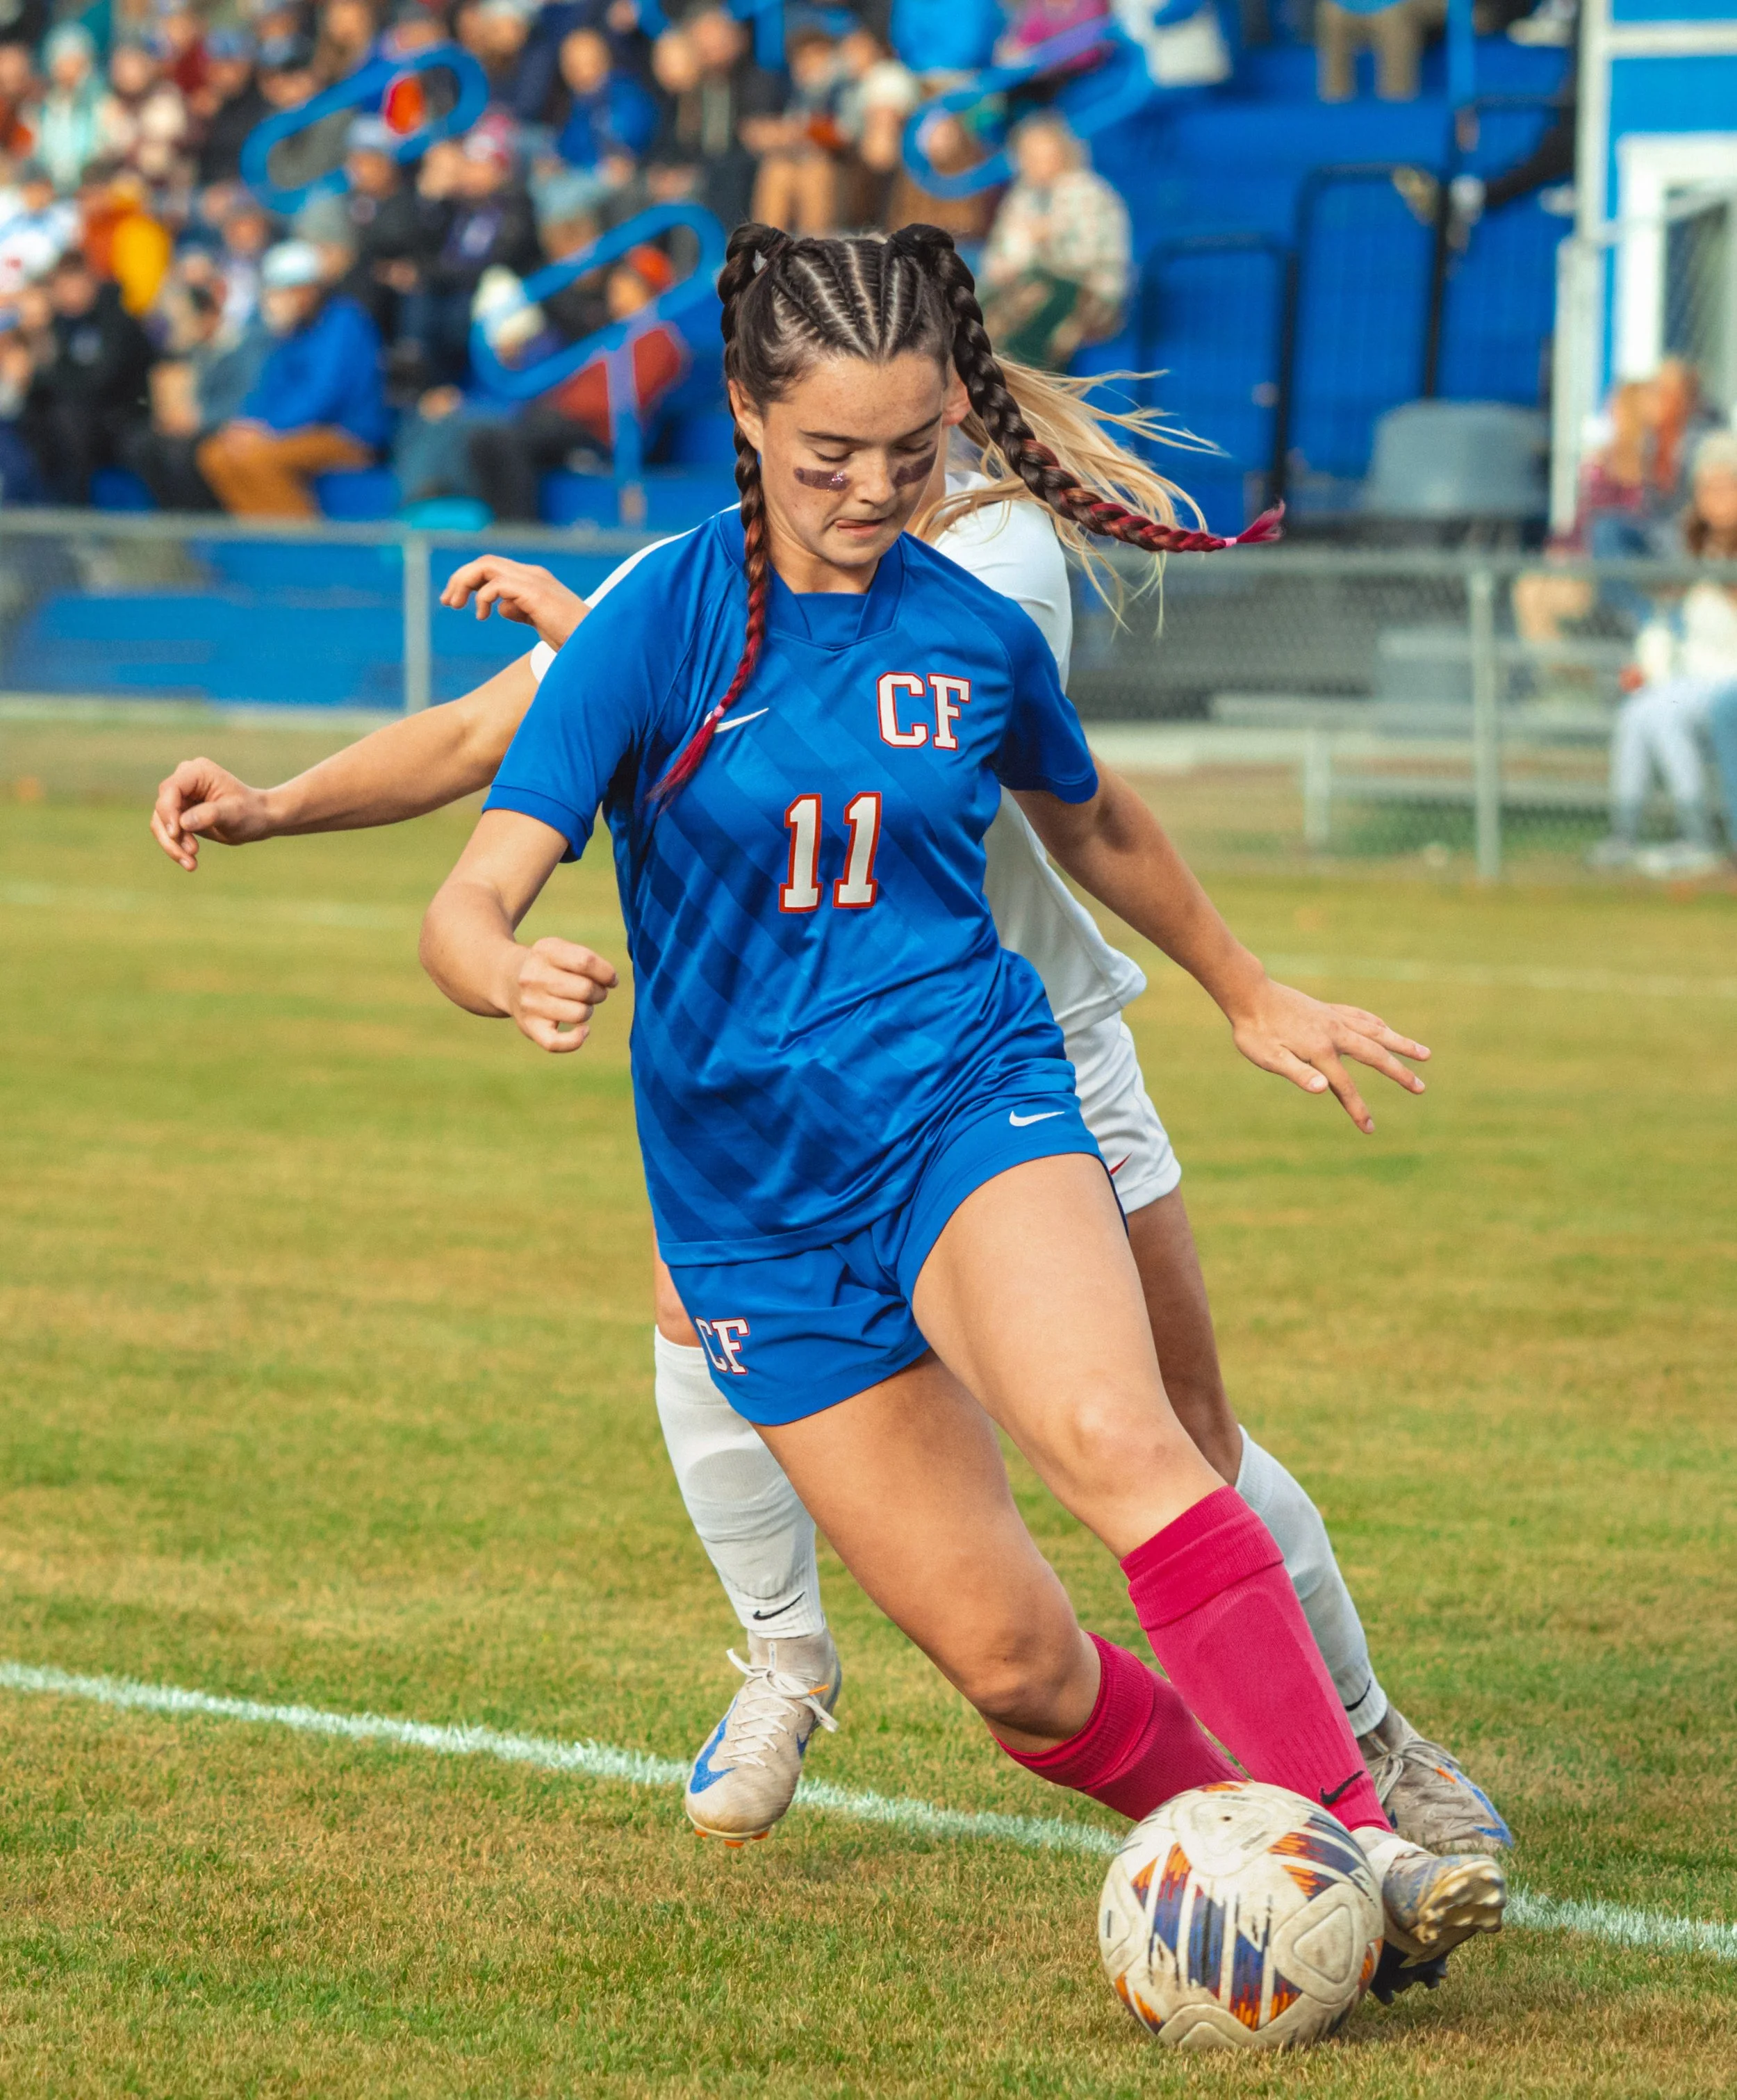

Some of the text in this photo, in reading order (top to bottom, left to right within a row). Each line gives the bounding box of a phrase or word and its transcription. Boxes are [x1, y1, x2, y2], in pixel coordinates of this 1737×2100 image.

[877, 671, 971, 751] CF
[778, 791, 882, 913] 11
[693, 1316, 750, 1375] CF
